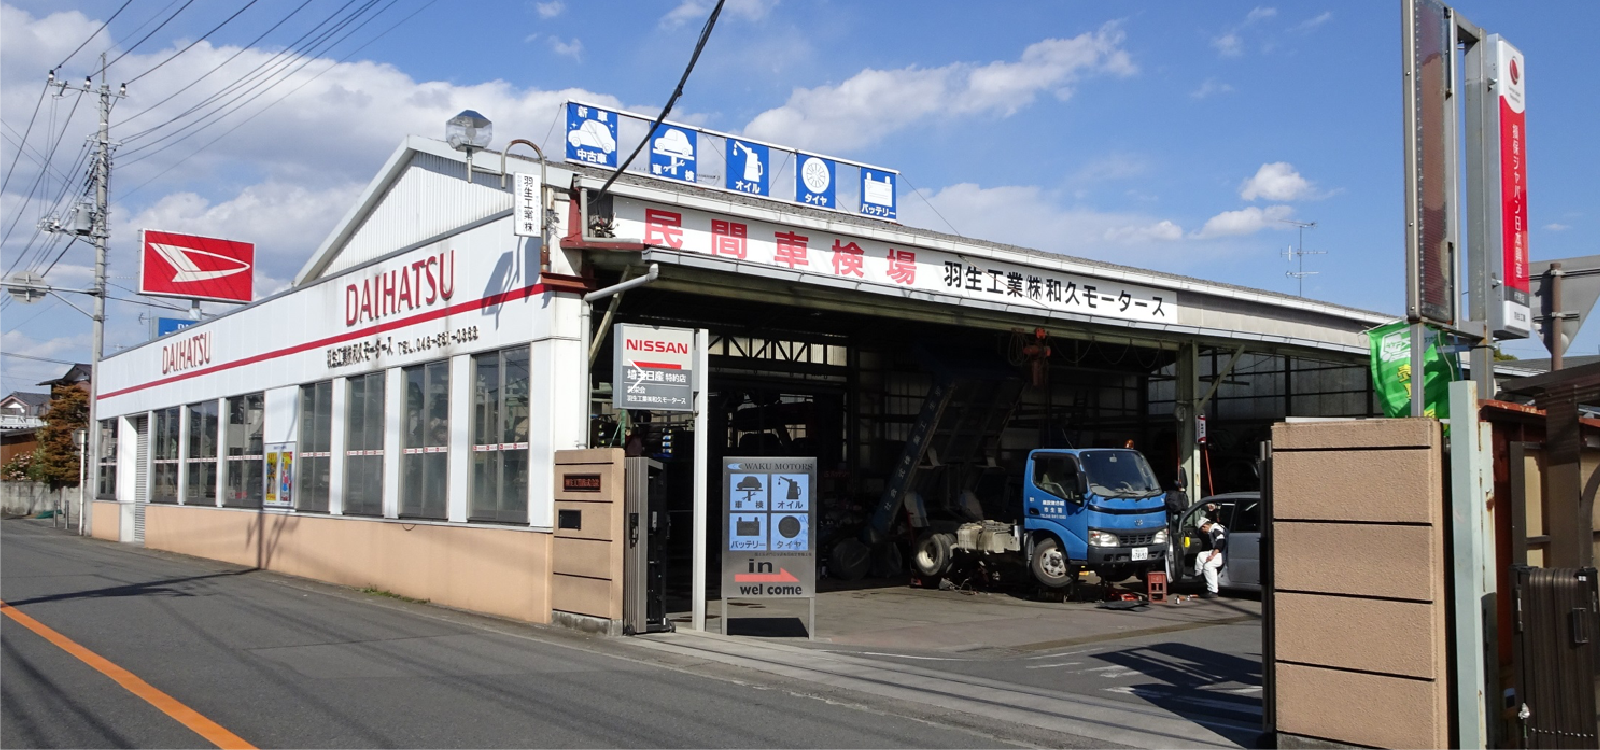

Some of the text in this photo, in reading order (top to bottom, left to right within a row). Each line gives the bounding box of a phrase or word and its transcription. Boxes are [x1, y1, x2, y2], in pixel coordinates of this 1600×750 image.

[577, 105, 609, 122] 新車
[576, 149, 609, 164] 中古車
[652, 164, 695, 183] 車検
[734, 179, 761, 195] オイル
[804, 193, 828, 206] タイヤ
[861, 204, 897, 218] バッテリー
[345, 250, 455, 327] DAIHATSU
[162, 330, 212, 375] DAIHATSU
[626, 338, 688, 355] NISSAN
[745, 462, 813, 471] WAKU MOTORS
[734, 500, 764, 509] 車検
[777, 500, 804, 509] オイル
[730, 540, 766, 549] バッテリー
[776, 540, 802, 549] タイヤ
[748, 558, 773, 574] in
